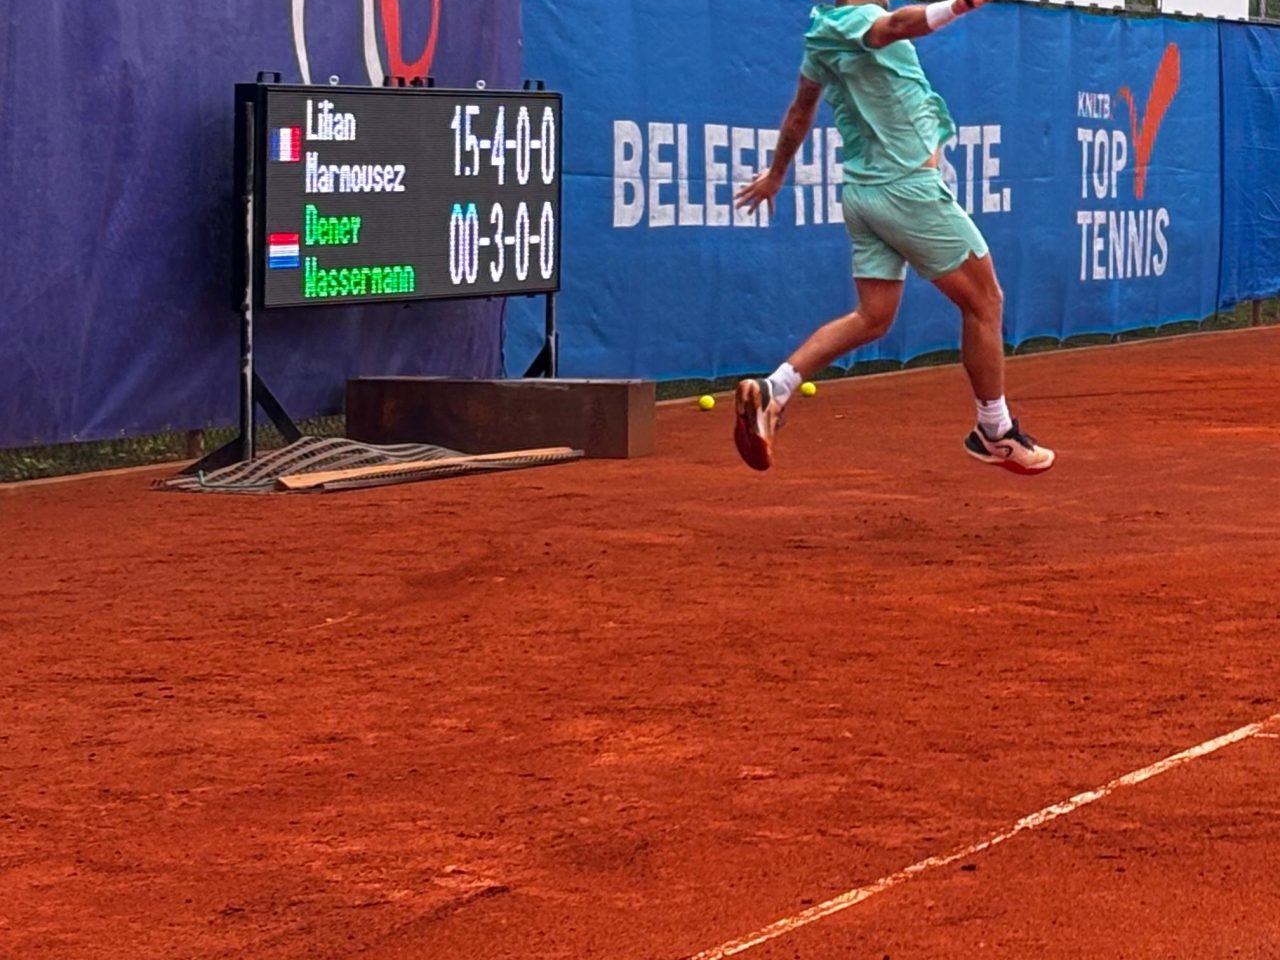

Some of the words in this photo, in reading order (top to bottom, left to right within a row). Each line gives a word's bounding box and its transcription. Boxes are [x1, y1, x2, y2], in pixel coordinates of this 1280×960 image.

[306, 99, 357, 141] Lilian
[1077, 91, 1111, 119] KNLTB
[613, 120, 783, 228] BELEEF
[1077, 127, 1128, 199] TOP
[1077, 207, 1170, 281] TENNIS
